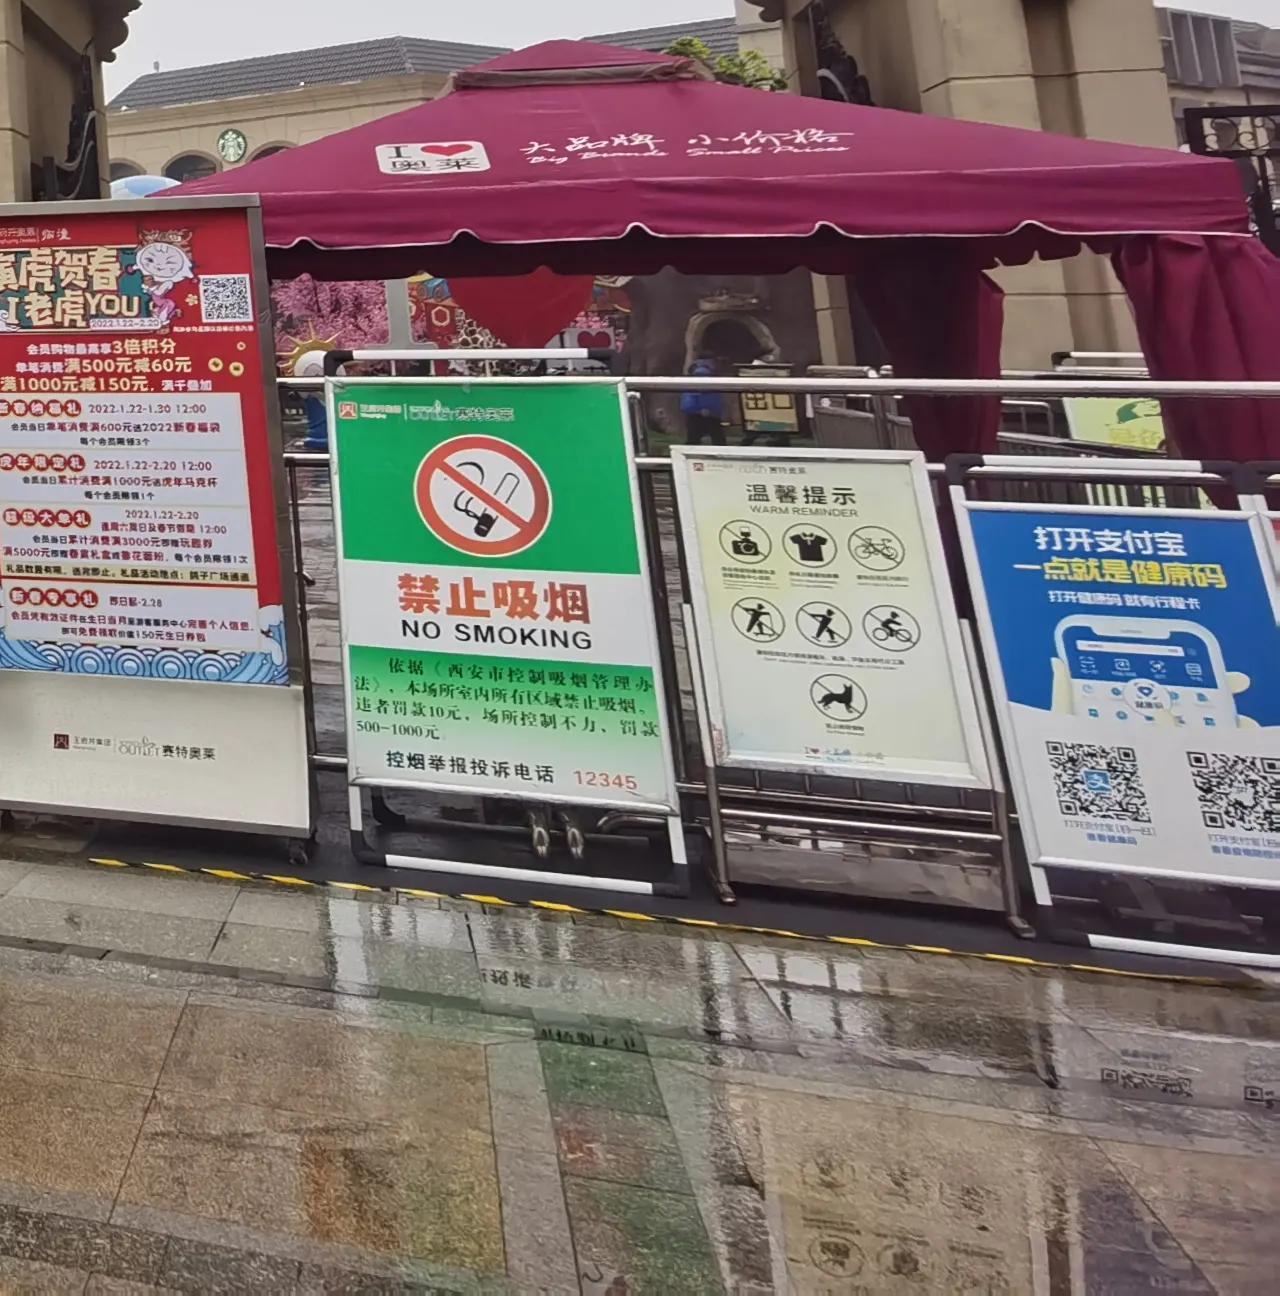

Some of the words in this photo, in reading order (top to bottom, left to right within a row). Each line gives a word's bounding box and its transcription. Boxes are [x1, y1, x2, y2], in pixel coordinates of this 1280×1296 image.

[388, 145, 411, 159] I
[392, 157, 481, 172] 奥莱
[176, 404, 206, 414] 12:00
[183, 461, 213, 471] 12:00
[746, 484, 857, 505] 温馨提示
[125, 510, 199, 520] 2022.1.22-2.20
[750, 505, 789, 515] WARM
[792, 507, 859, 518] REMINDER
[200, 525, 227, 535] 12:00
[1034, 526, 1188, 556] 打开支付宝
[1013, 557, 1228, 589] 一点就是健康码
[398, 573, 591, 624] 禁止吸烟
[401, 619, 440, 640] NO
[455, 624, 592, 650] SMOKING
[386, 750, 555, 784] 控烟举报投诉电话
[575, 770, 638, 790] 12345
